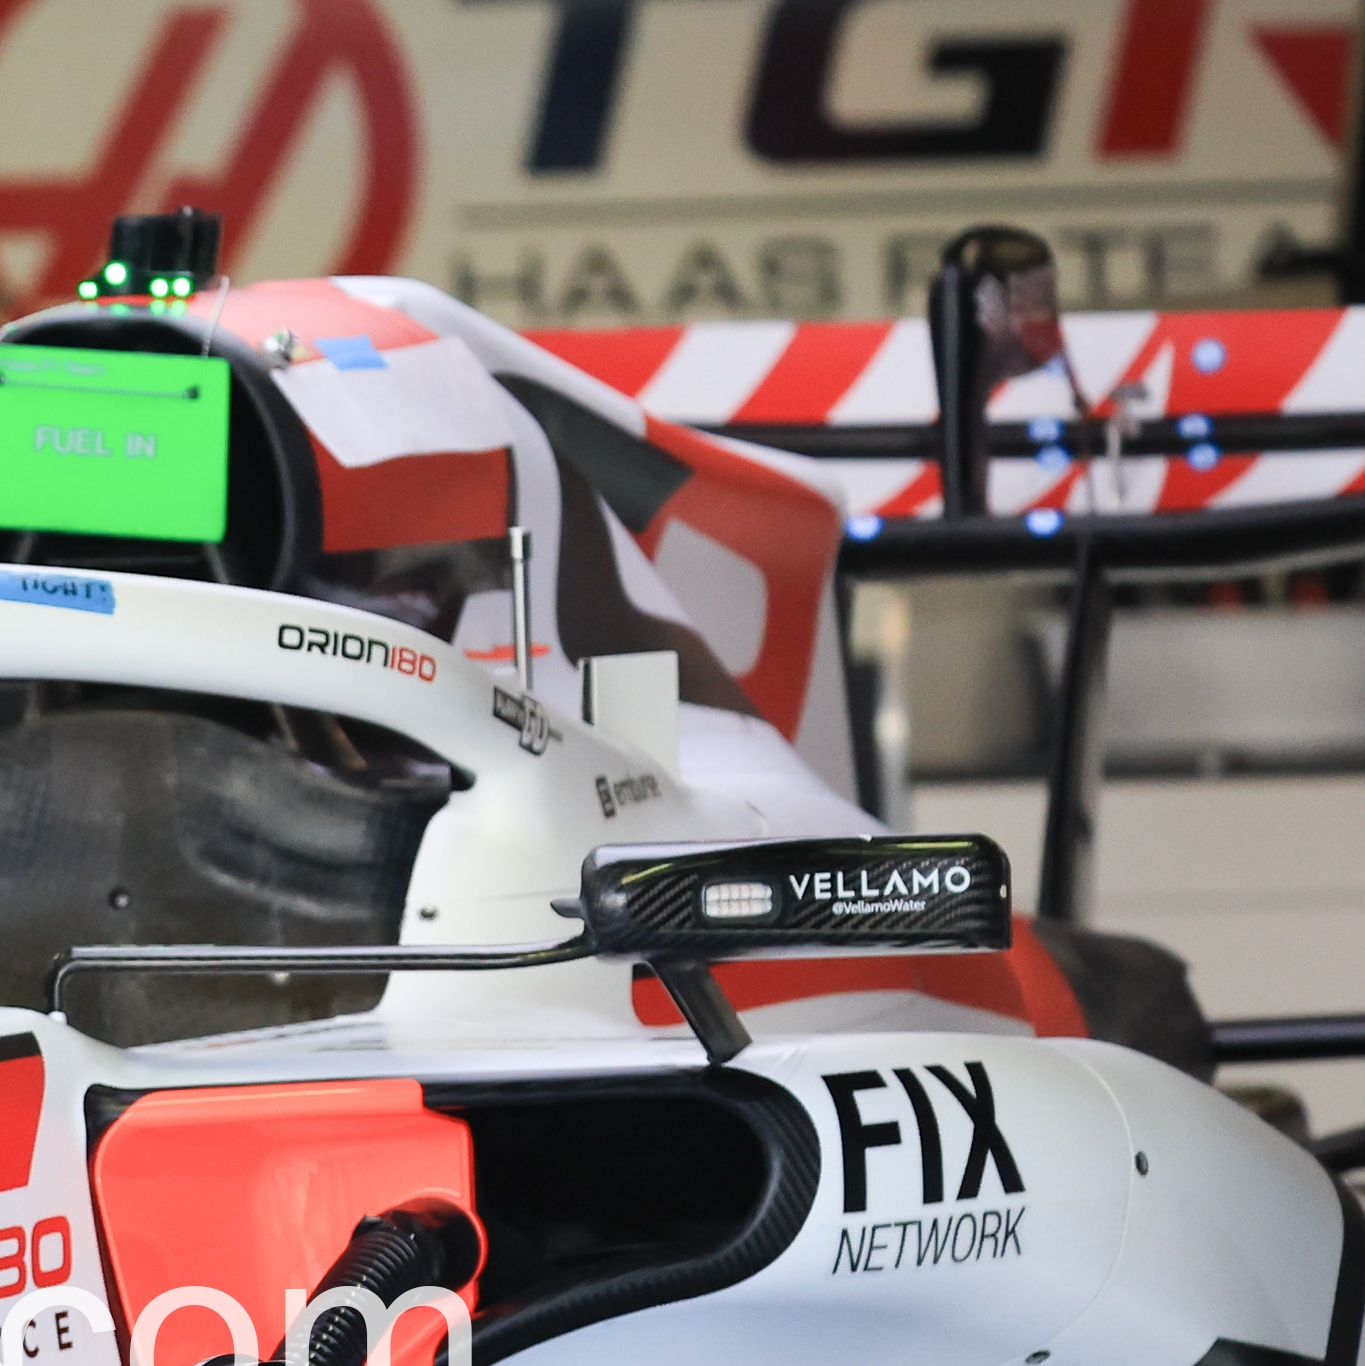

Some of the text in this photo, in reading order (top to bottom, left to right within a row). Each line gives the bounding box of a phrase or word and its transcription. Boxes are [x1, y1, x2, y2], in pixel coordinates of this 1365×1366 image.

[34, 424, 158, 460] FUEL IN
[277, 623, 437, 683] ORION180
[788, 865, 972, 900] VELLAMO
[832, 898, 926, 916] @VellamoWater
[820, 1060, 1027, 1214] FIX
[831, 1205, 1026, 1276] NETWORK
